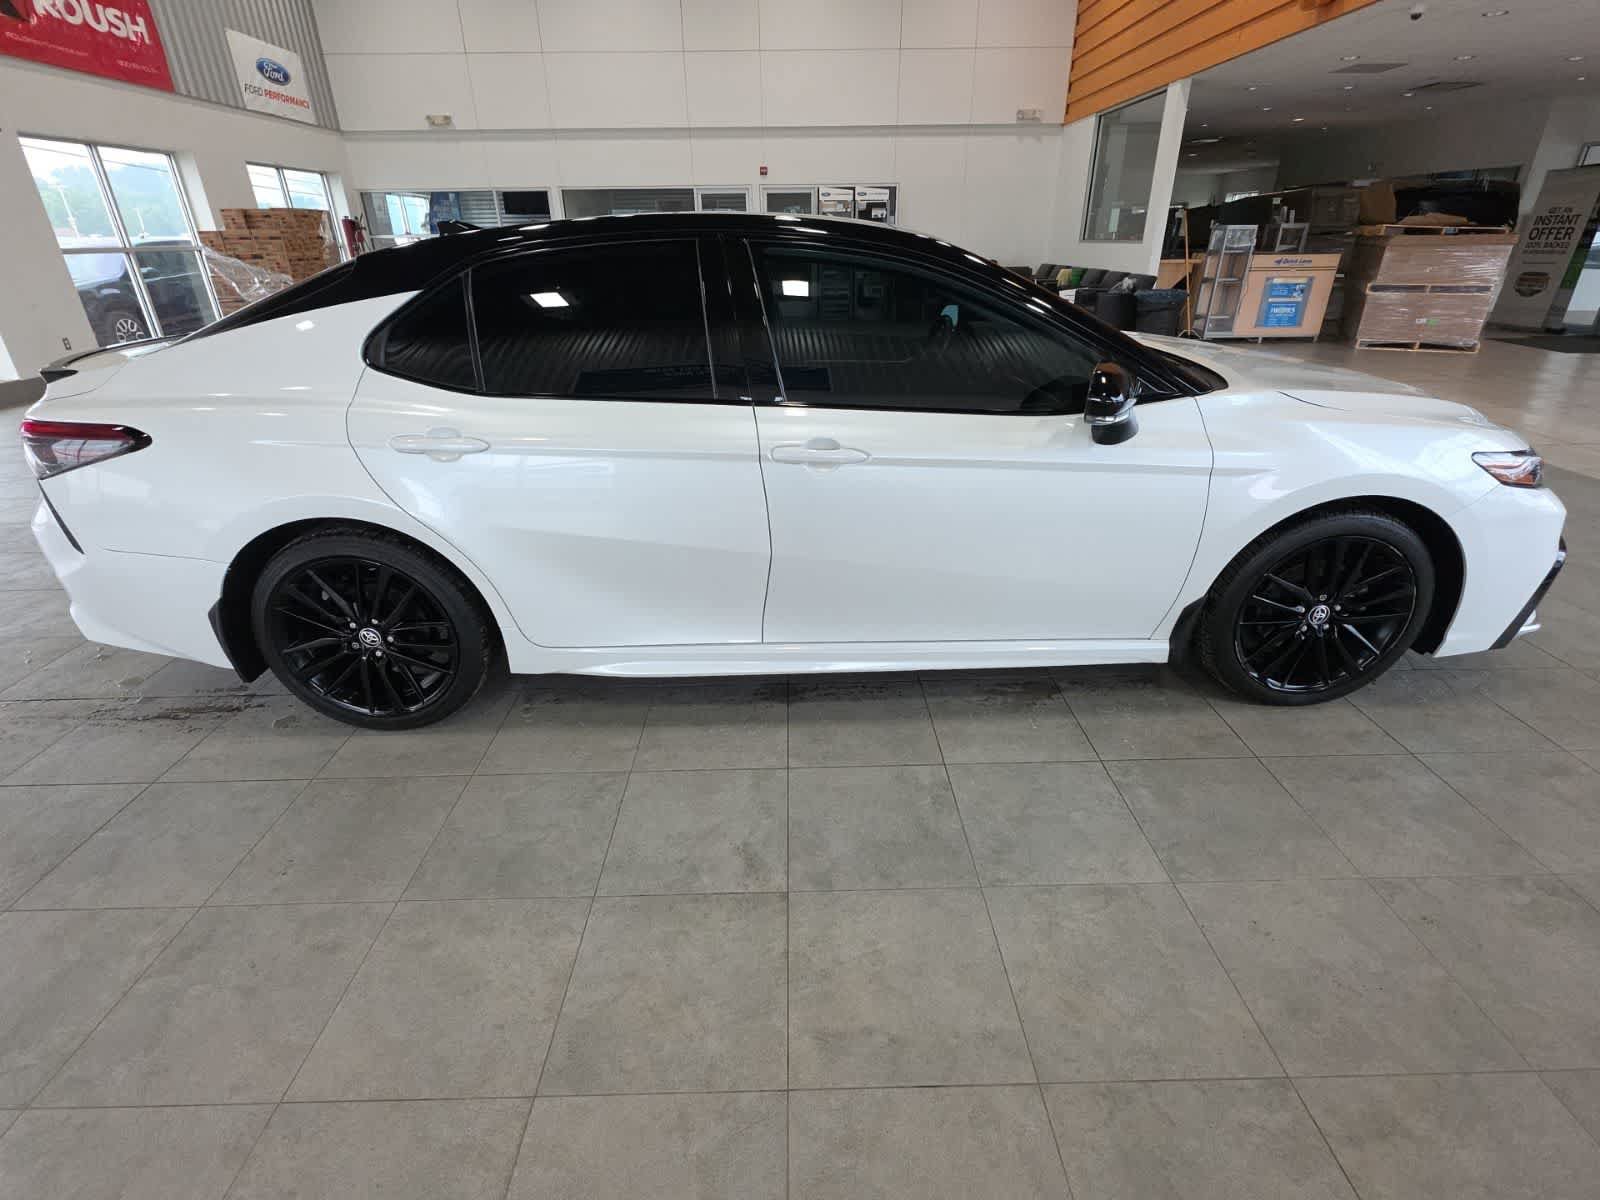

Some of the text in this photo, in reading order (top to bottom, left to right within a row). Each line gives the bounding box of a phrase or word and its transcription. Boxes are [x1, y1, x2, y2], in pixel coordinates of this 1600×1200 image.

[33, 0, 150, 43] ROUSH
[244, 83, 263, 96] FORD
[1533, 214, 1582, 226] INSTANT
[1528, 227, 1575, 241] OFFER
